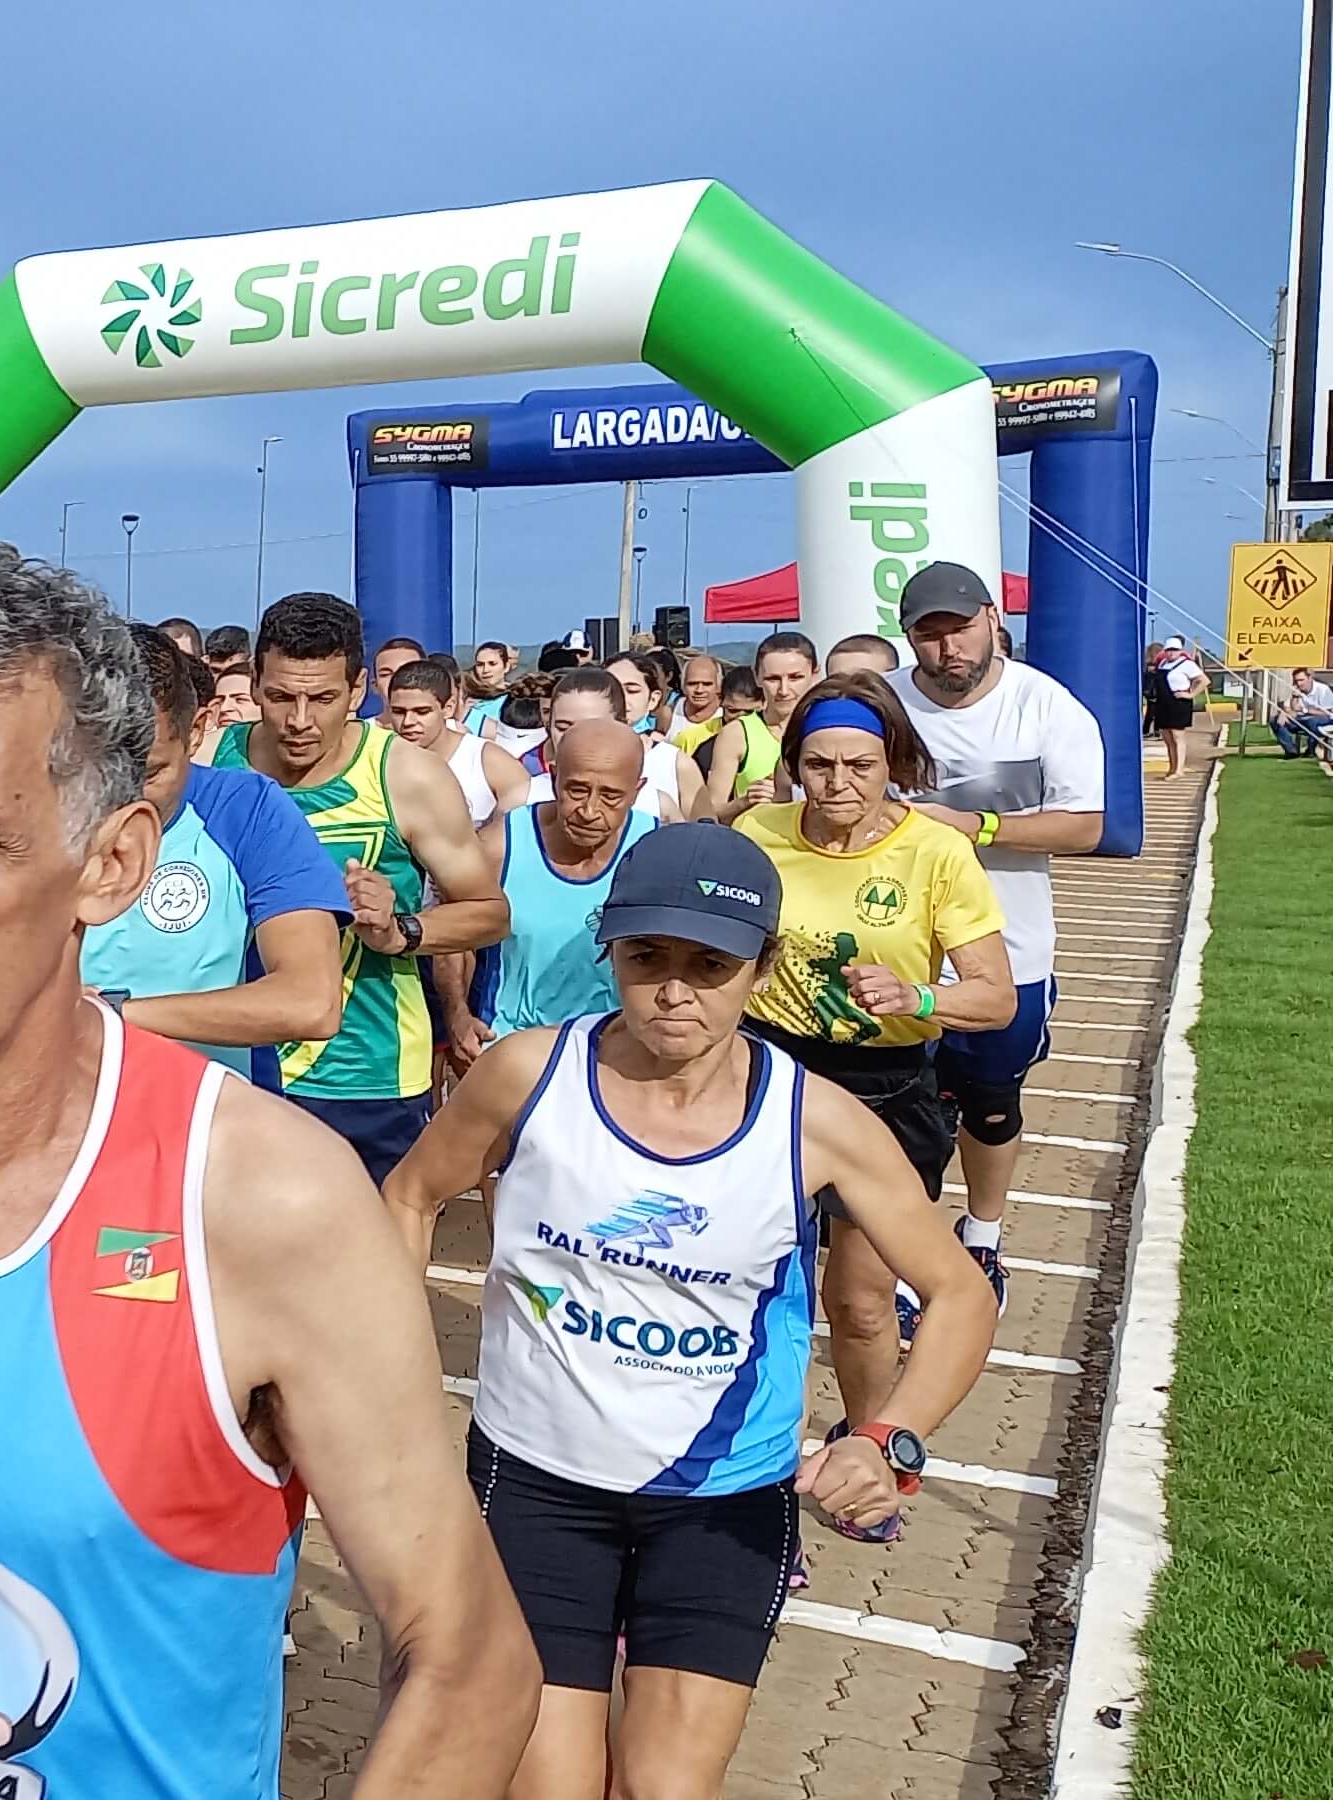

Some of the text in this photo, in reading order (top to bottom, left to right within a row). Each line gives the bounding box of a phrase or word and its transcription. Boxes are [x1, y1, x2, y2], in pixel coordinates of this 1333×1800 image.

[229, 231, 582, 346] Sicredi
[374, 424, 473, 444] SYGMA
[552, 403, 755, 450] LARGADA/C
[1236, 632, 1316, 645] ELEVADA
[1252, 616, 1302, 628] FAIXA
[536, 1220, 732, 1286] RAL RUNNER
[561, 1299, 740, 1358] SICOOB
